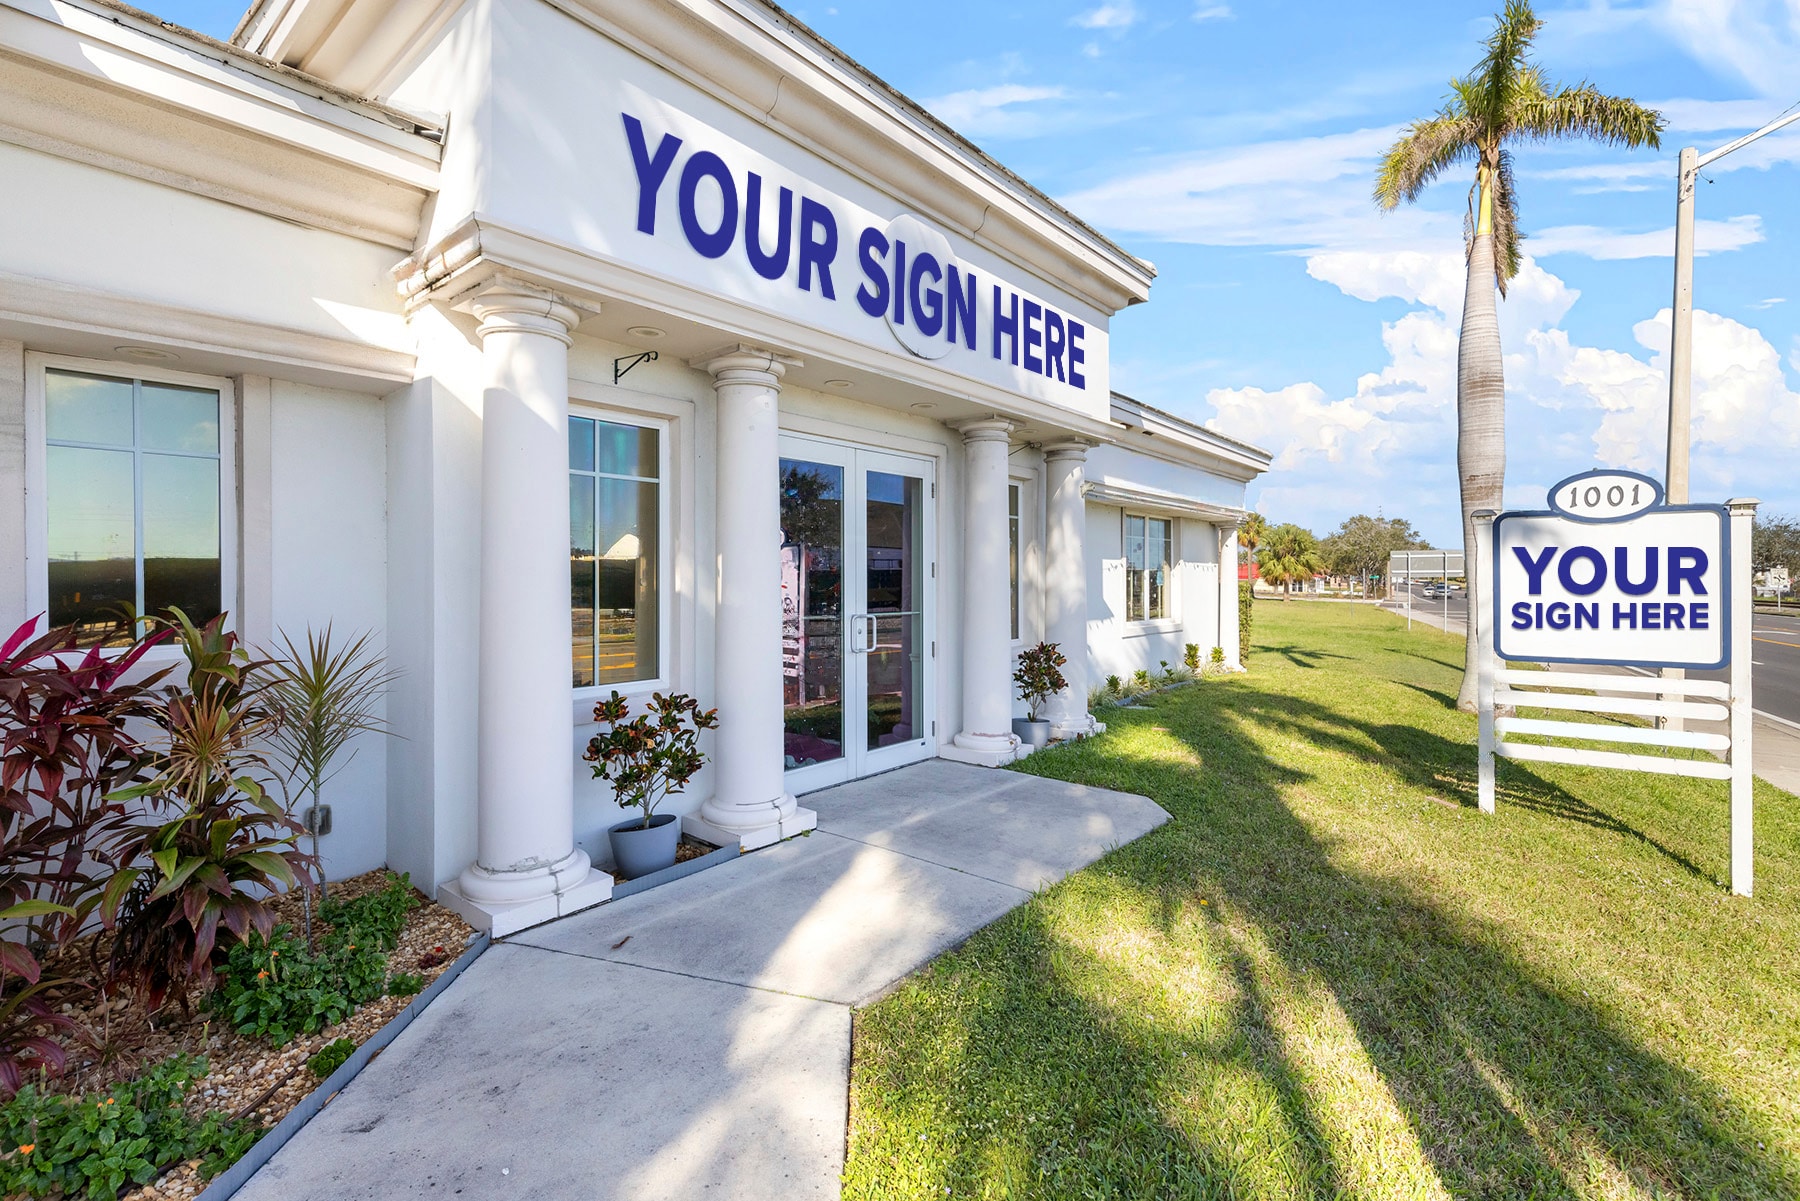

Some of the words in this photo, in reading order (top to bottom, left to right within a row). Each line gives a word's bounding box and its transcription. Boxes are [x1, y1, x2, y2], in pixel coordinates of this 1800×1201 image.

[621, 112, 838, 301] YOUR
[856, 226, 977, 351] SIGN
[993, 284, 1086, 390] HERE
[1569, 484, 1641, 508] 1001
[1511, 545, 1709, 597] YOUR
[1511, 601, 1599, 631] SIGN
[1612, 602, 1709, 630] HERE
